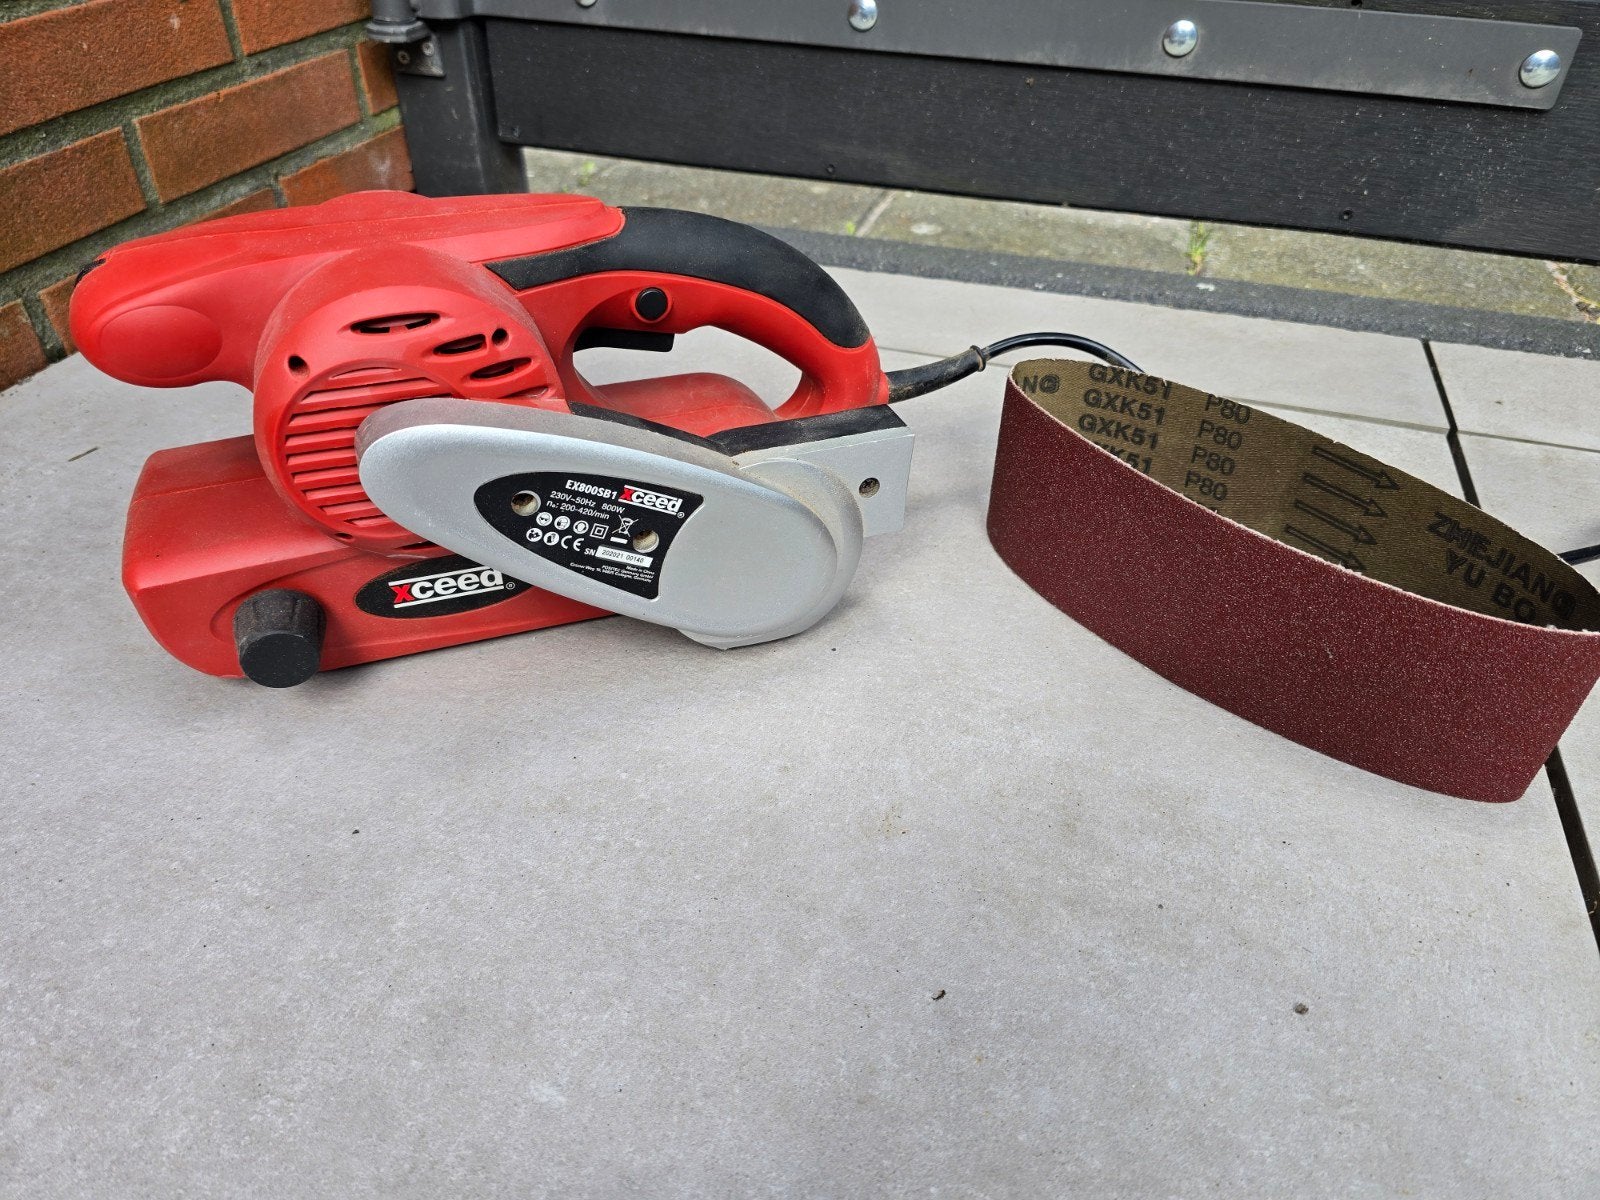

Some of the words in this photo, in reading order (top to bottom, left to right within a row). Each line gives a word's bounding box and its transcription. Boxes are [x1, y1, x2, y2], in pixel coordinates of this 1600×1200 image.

[1088, 363, 1173, 399] GXK51
[1204, 393, 1251, 424] P80
[1083, 388, 1166, 426] GXK51
[1198, 419, 1243, 450] P80
[1078, 413, 1159, 450] GXK51
[1191, 444, 1236, 476] P80
[565, 479, 618, 500] EX800SB1
[618, 486, 683, 514] xceed
[1184, 469, 1228, 501] P80
[560, 502, 610, 520] 200-420/min
[601, 502, 625, 514] 800W
[584, 547, 596, 557] SN
[390, 568, 504, 606] xceed
[1446, 549, 1487, 588] YU
[1491, 582, 1536, 624] BO
